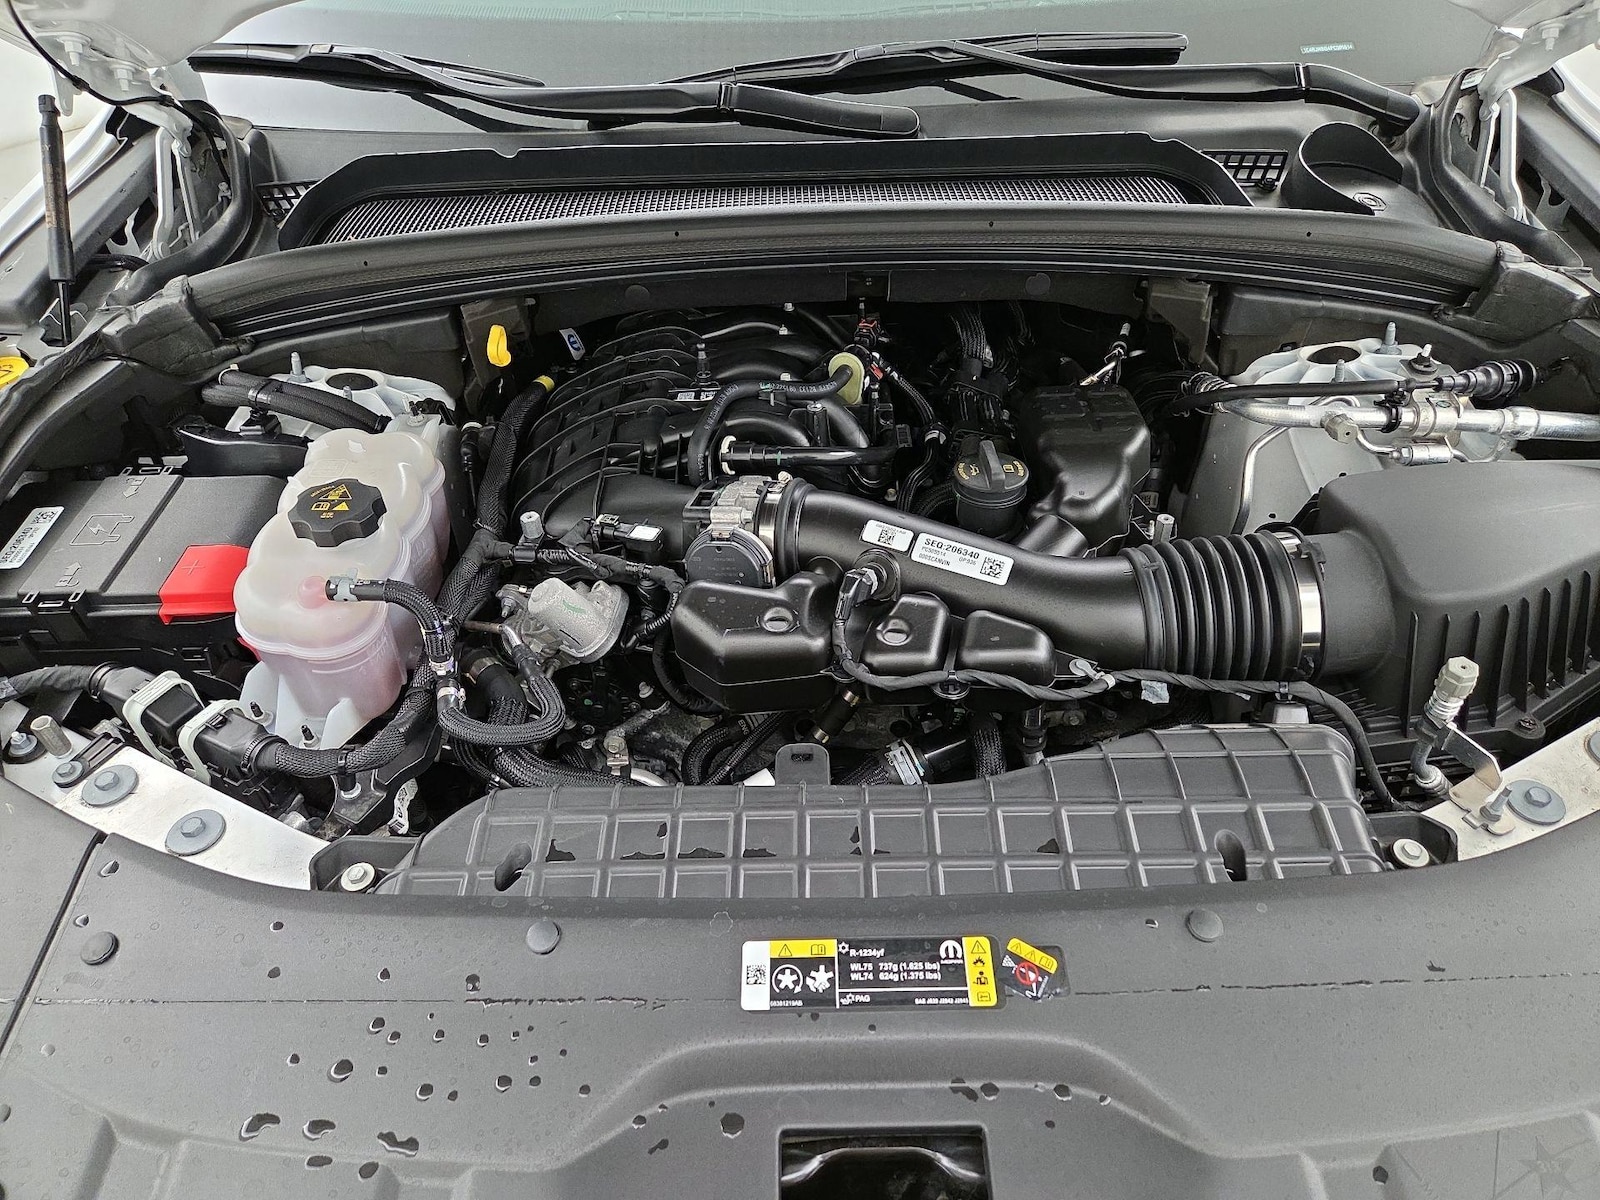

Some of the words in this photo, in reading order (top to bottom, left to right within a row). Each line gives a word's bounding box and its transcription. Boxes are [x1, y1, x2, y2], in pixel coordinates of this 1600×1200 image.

[924, 538, 980, 560] SEQ:206340
[849, 948, 885, 958] R-1234yf
[850, 962, 873, 971] WL75
[878, 962, 898, 972] 737g
[900, 962, 923, 972] (1.625
[924, 961, 941, 971] lbs)
[850, 972, 874, 981] WL74
[878, 972, 899, 982] 624g
[900, 971, 924, 982] (1.375
[925, 971, 942, 981] lbs)
[855, 994, 871, 1002] PAG
